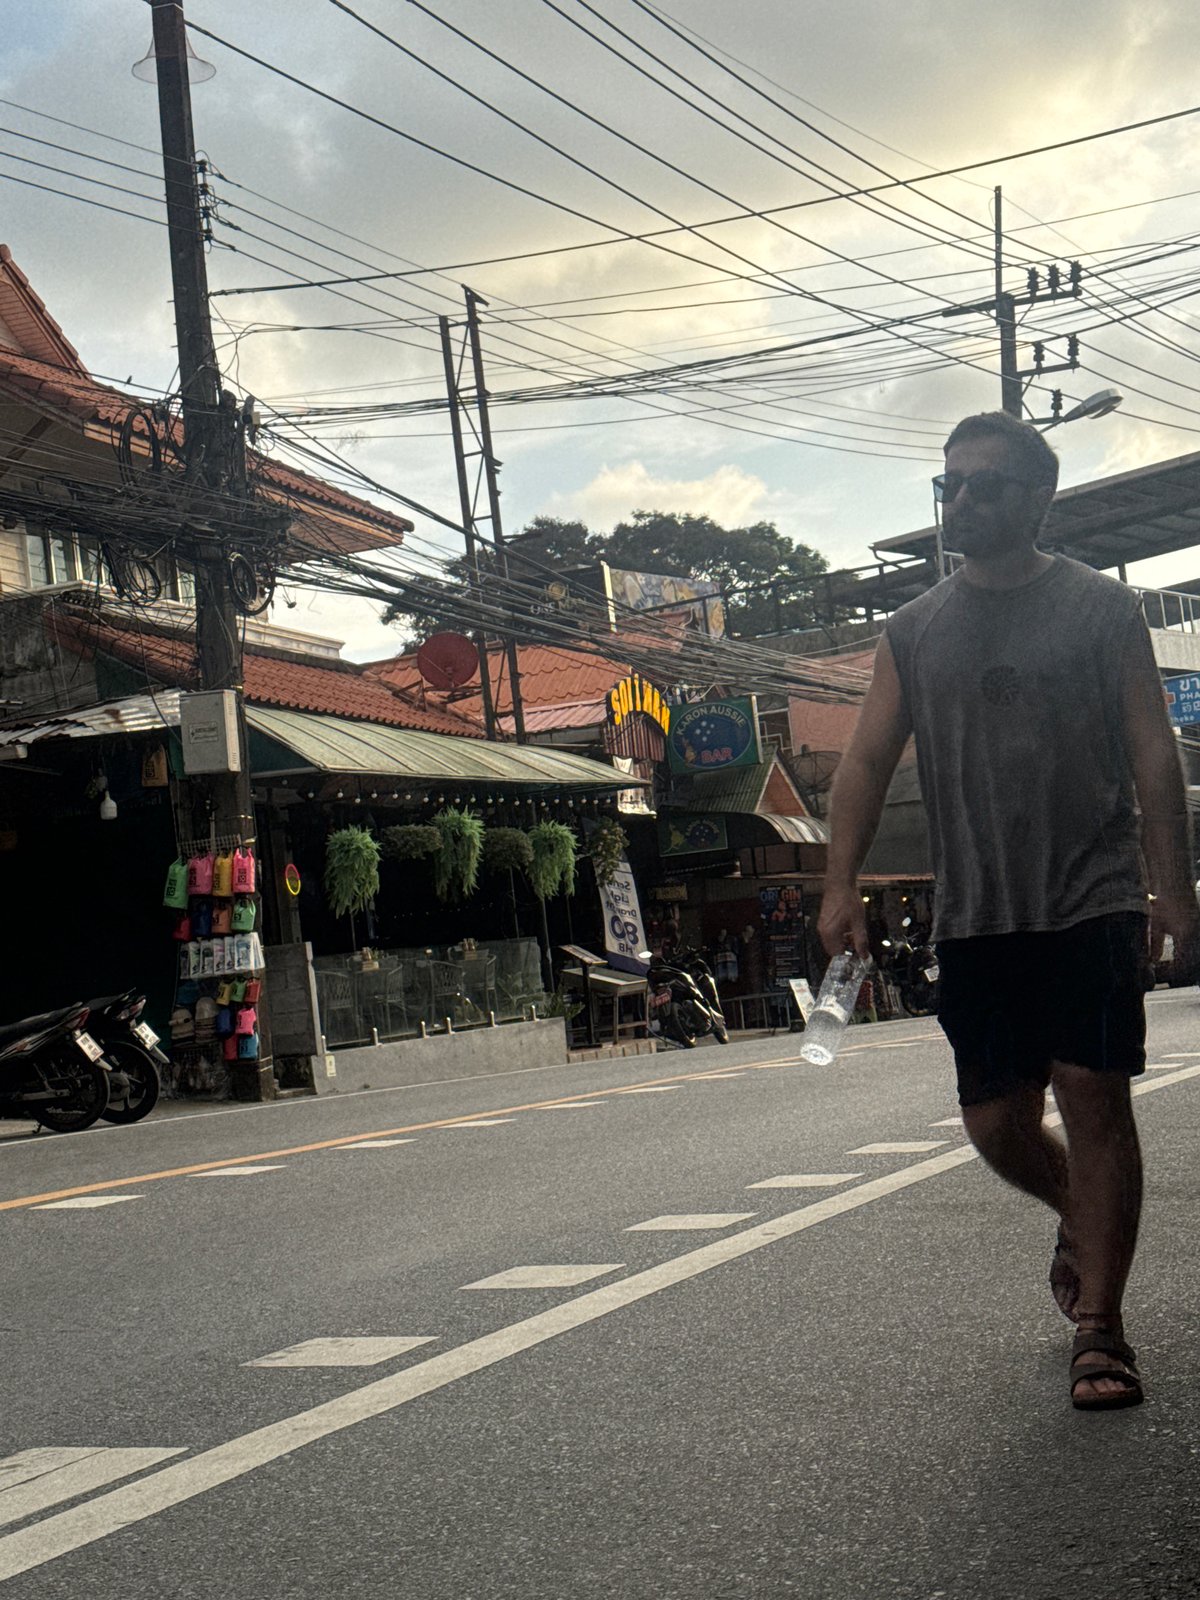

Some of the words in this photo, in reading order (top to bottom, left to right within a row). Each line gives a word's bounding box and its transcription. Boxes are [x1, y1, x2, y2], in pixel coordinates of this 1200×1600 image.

[676, 709, 708, 735] KARON
[710, 706, 746, 727] AUSSIE
[702, 748, 733, 763] BAR
